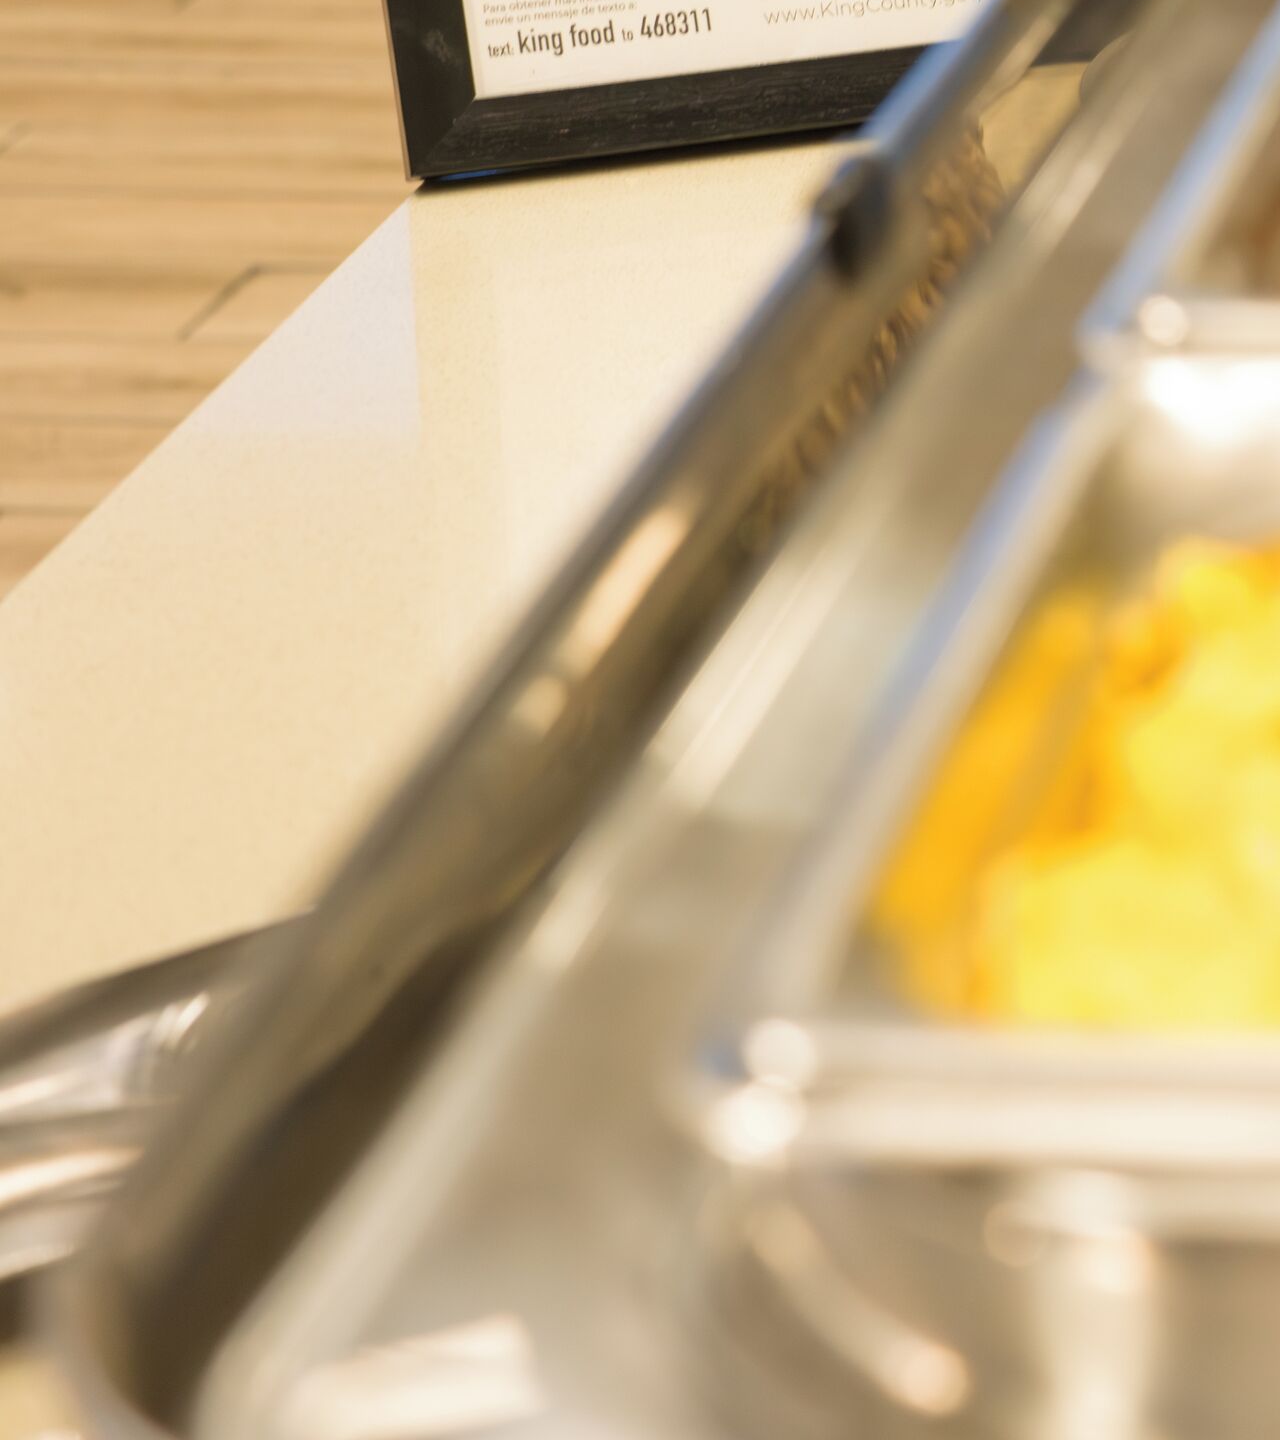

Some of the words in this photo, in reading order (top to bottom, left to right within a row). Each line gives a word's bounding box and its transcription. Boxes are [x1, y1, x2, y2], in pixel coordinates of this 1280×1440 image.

[483, 2, 507, 15] Para
[517, 13, 531, 24] un
[533, 6, 580, 23] mensaje
[581, 3, 596, 16] de
[597, 0, 626, 14] texto
[488, 42, 515, 57] text:
[517, 24, 564, 56] king
[570, 19, 615, 48] food
[622, 28, 634, 41] to
[641, 8, 712, 38] 468311
